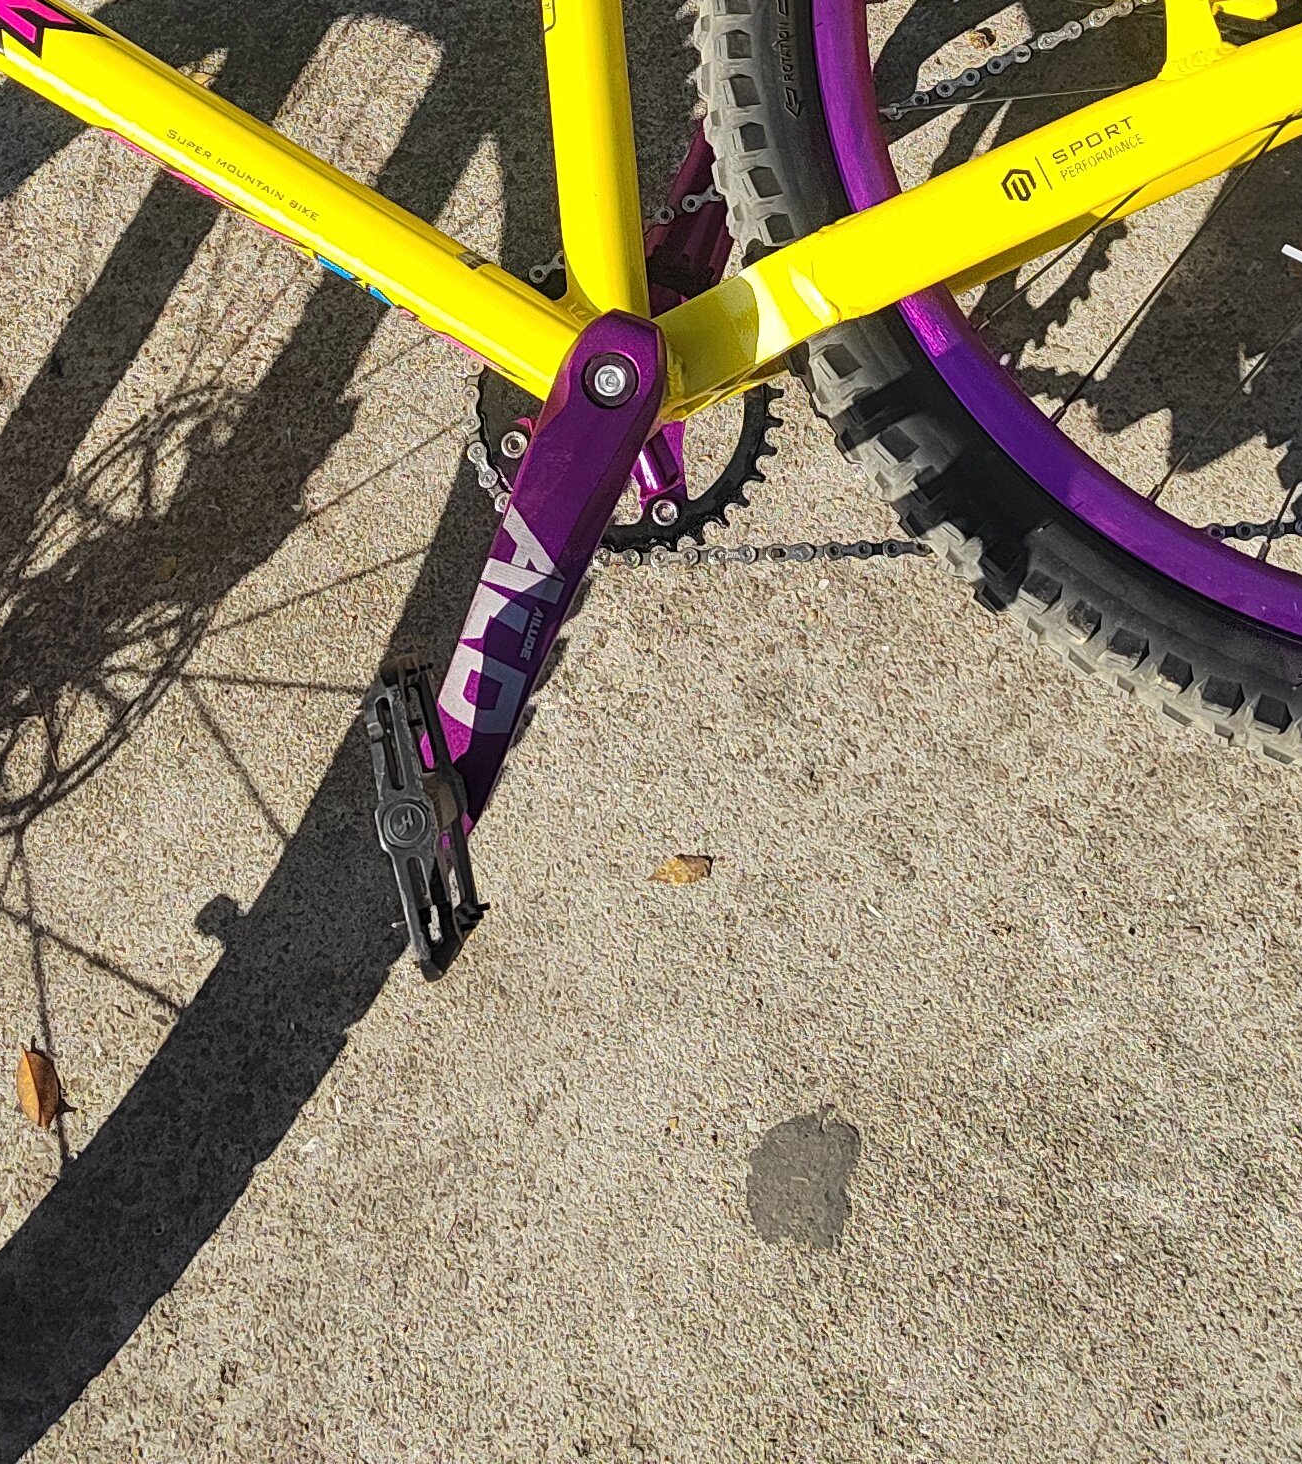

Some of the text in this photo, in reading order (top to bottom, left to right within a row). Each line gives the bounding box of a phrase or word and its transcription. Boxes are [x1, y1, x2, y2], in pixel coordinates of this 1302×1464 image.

[1052, 115, 1133, 165] SPORT
[1059, 133, 1145, 182] PERFORMANCE
[166, 128, 320, 222] SUPER MOUNTAIN BIKE
[520, 604, 546, 662] AILUDE
